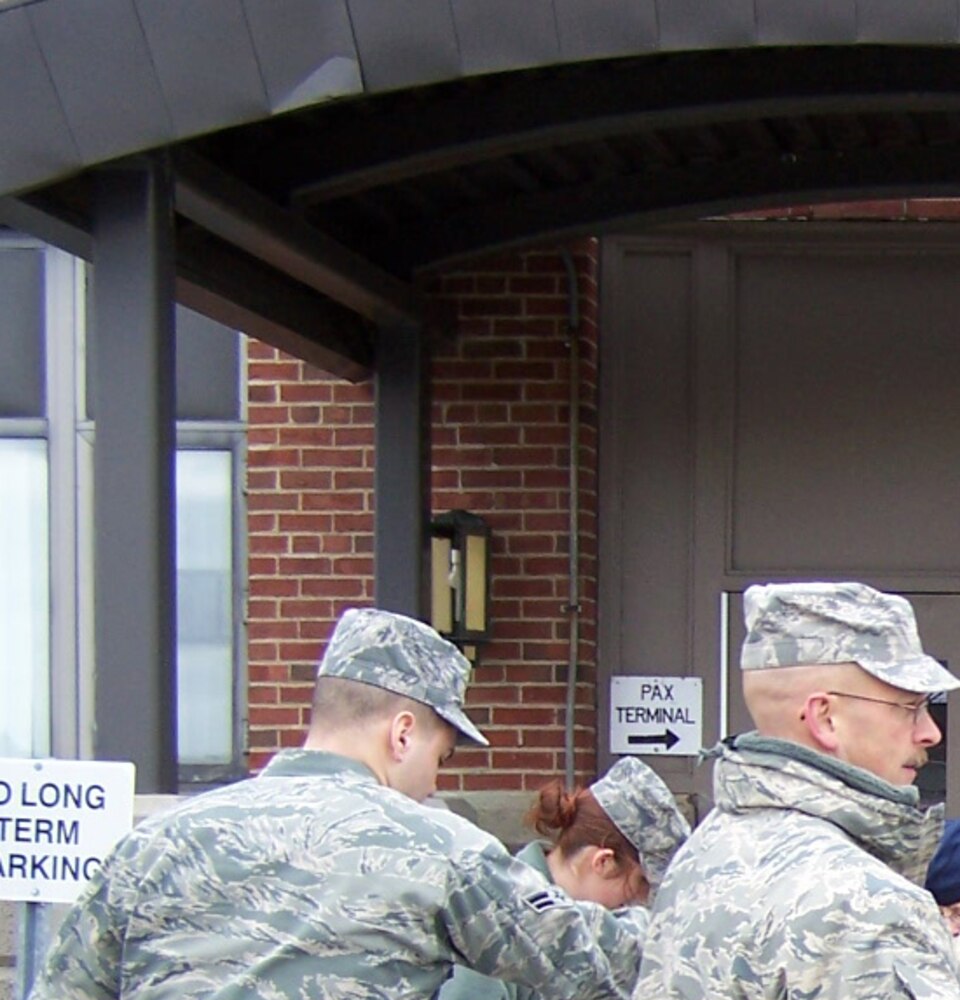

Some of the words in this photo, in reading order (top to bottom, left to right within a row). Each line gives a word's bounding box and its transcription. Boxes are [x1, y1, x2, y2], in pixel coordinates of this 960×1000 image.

[641, 683, 674, 701] PAX
[616, 706, 695, 725] TERMINAL
[21, 781, 106, 810] LONG
[0, 817, 79, 845] TERM
[0, 853, 102, 881] RKING
